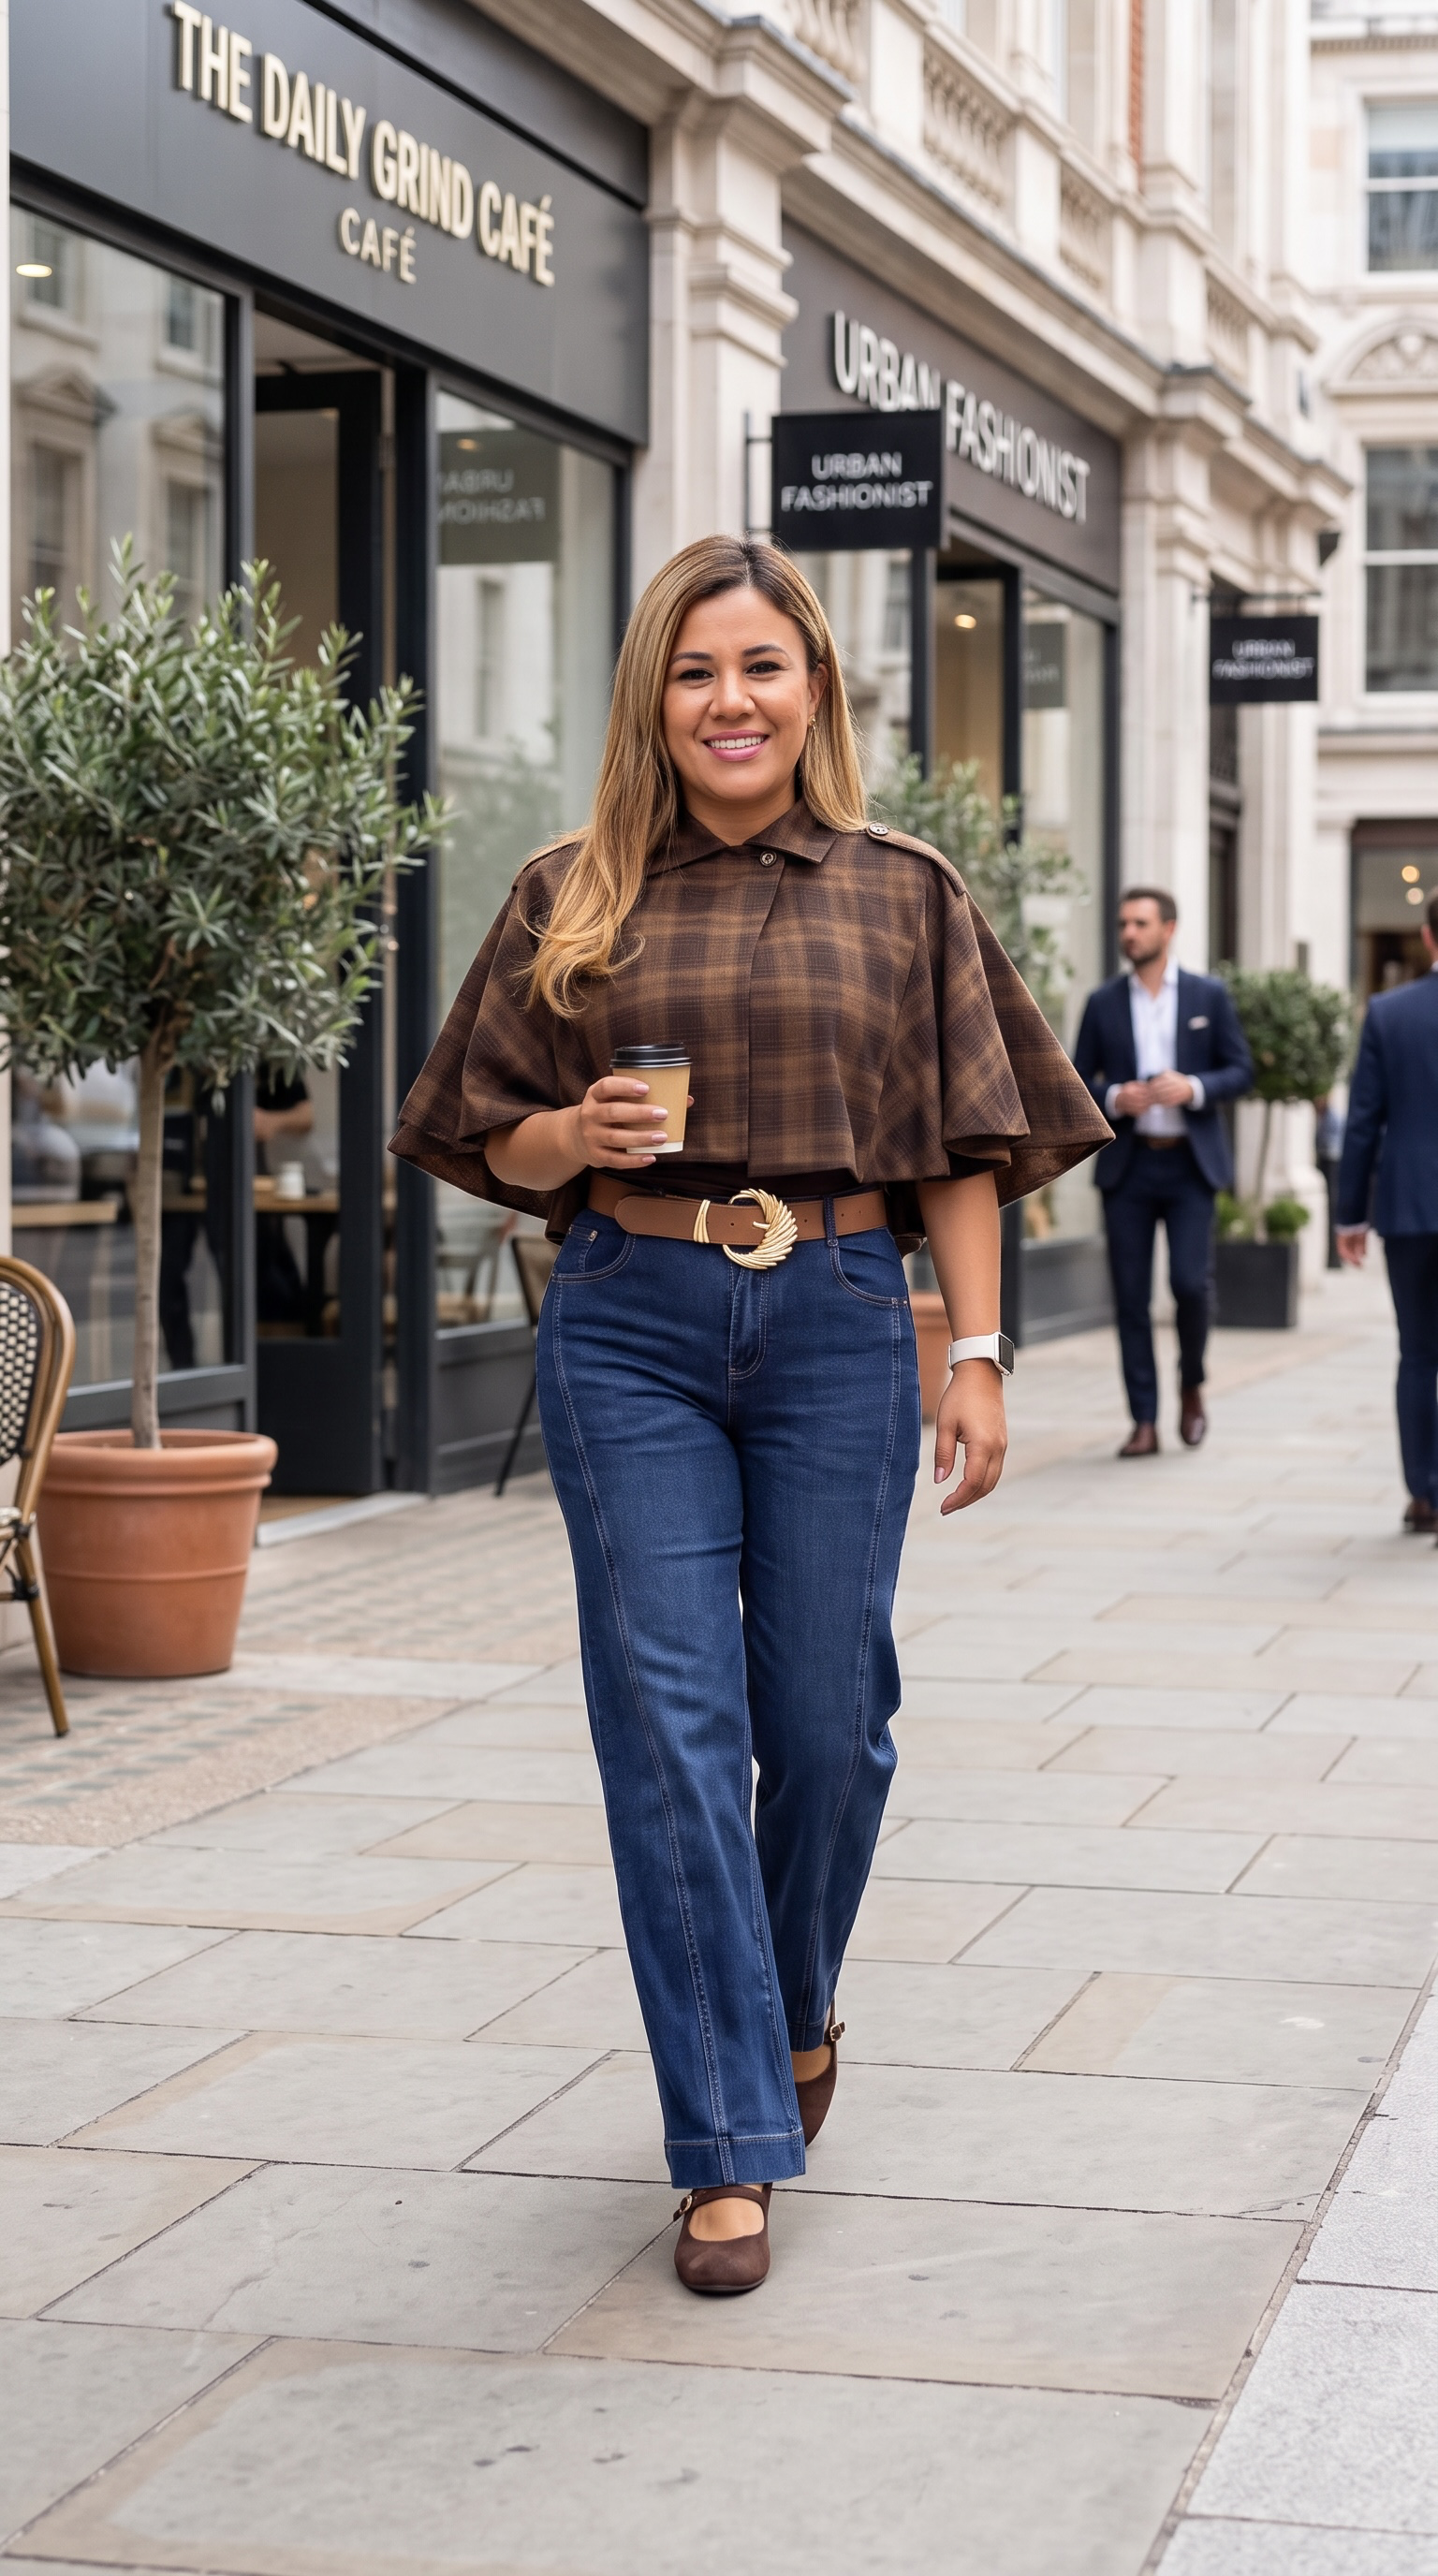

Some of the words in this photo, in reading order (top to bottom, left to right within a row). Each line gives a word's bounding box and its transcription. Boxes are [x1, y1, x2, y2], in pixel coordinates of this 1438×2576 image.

[173, 1, 253, 123] THE
[261, 52, 366, 180] DAILY
[373, 120, 473, 240] GRIND
[478, 181, 555, 286] CAFÉ
[340, 208, 417, 284] CAFÉ
[811, 451, 902, 480] URBAN
[946, 379, 1090, 523] FASHIONIST
[781, 480, 934, 511] FASHIONIST
